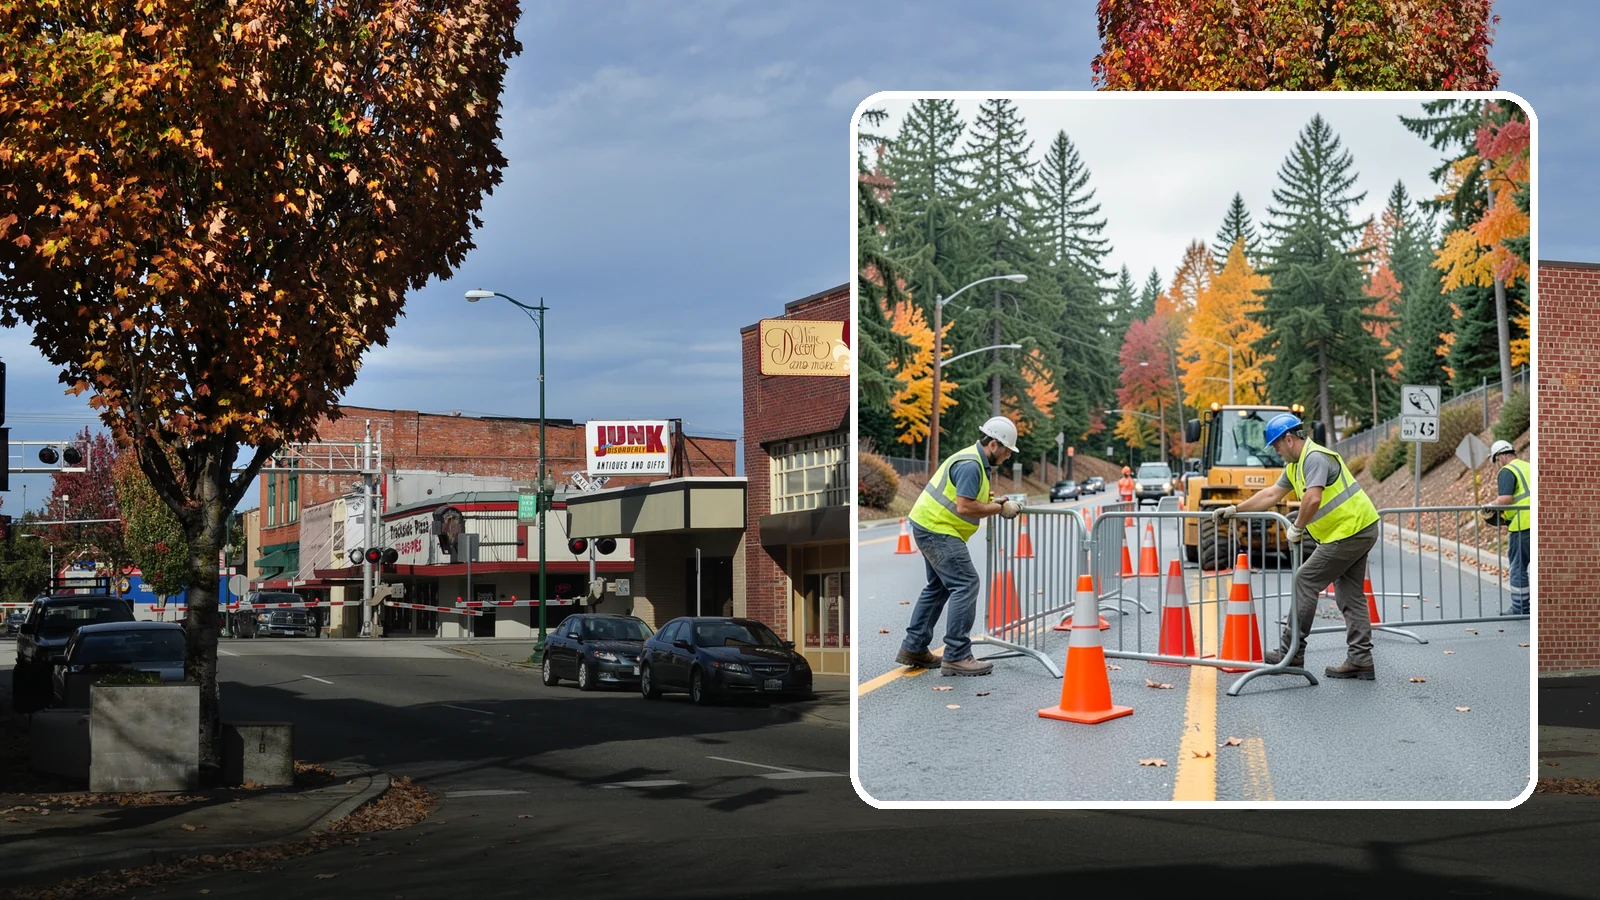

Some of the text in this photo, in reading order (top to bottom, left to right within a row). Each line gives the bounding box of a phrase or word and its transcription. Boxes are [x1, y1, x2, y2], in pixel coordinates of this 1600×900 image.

[765, 328, 831, 365] Decor
[595, 425, 664, 457] JUNK
[607, 446, 646, 454] DISORDERLY
[597, 460, 665, 470] ANTIQUES AND GIFTS
[414, 519, 429, 535] Pizza
